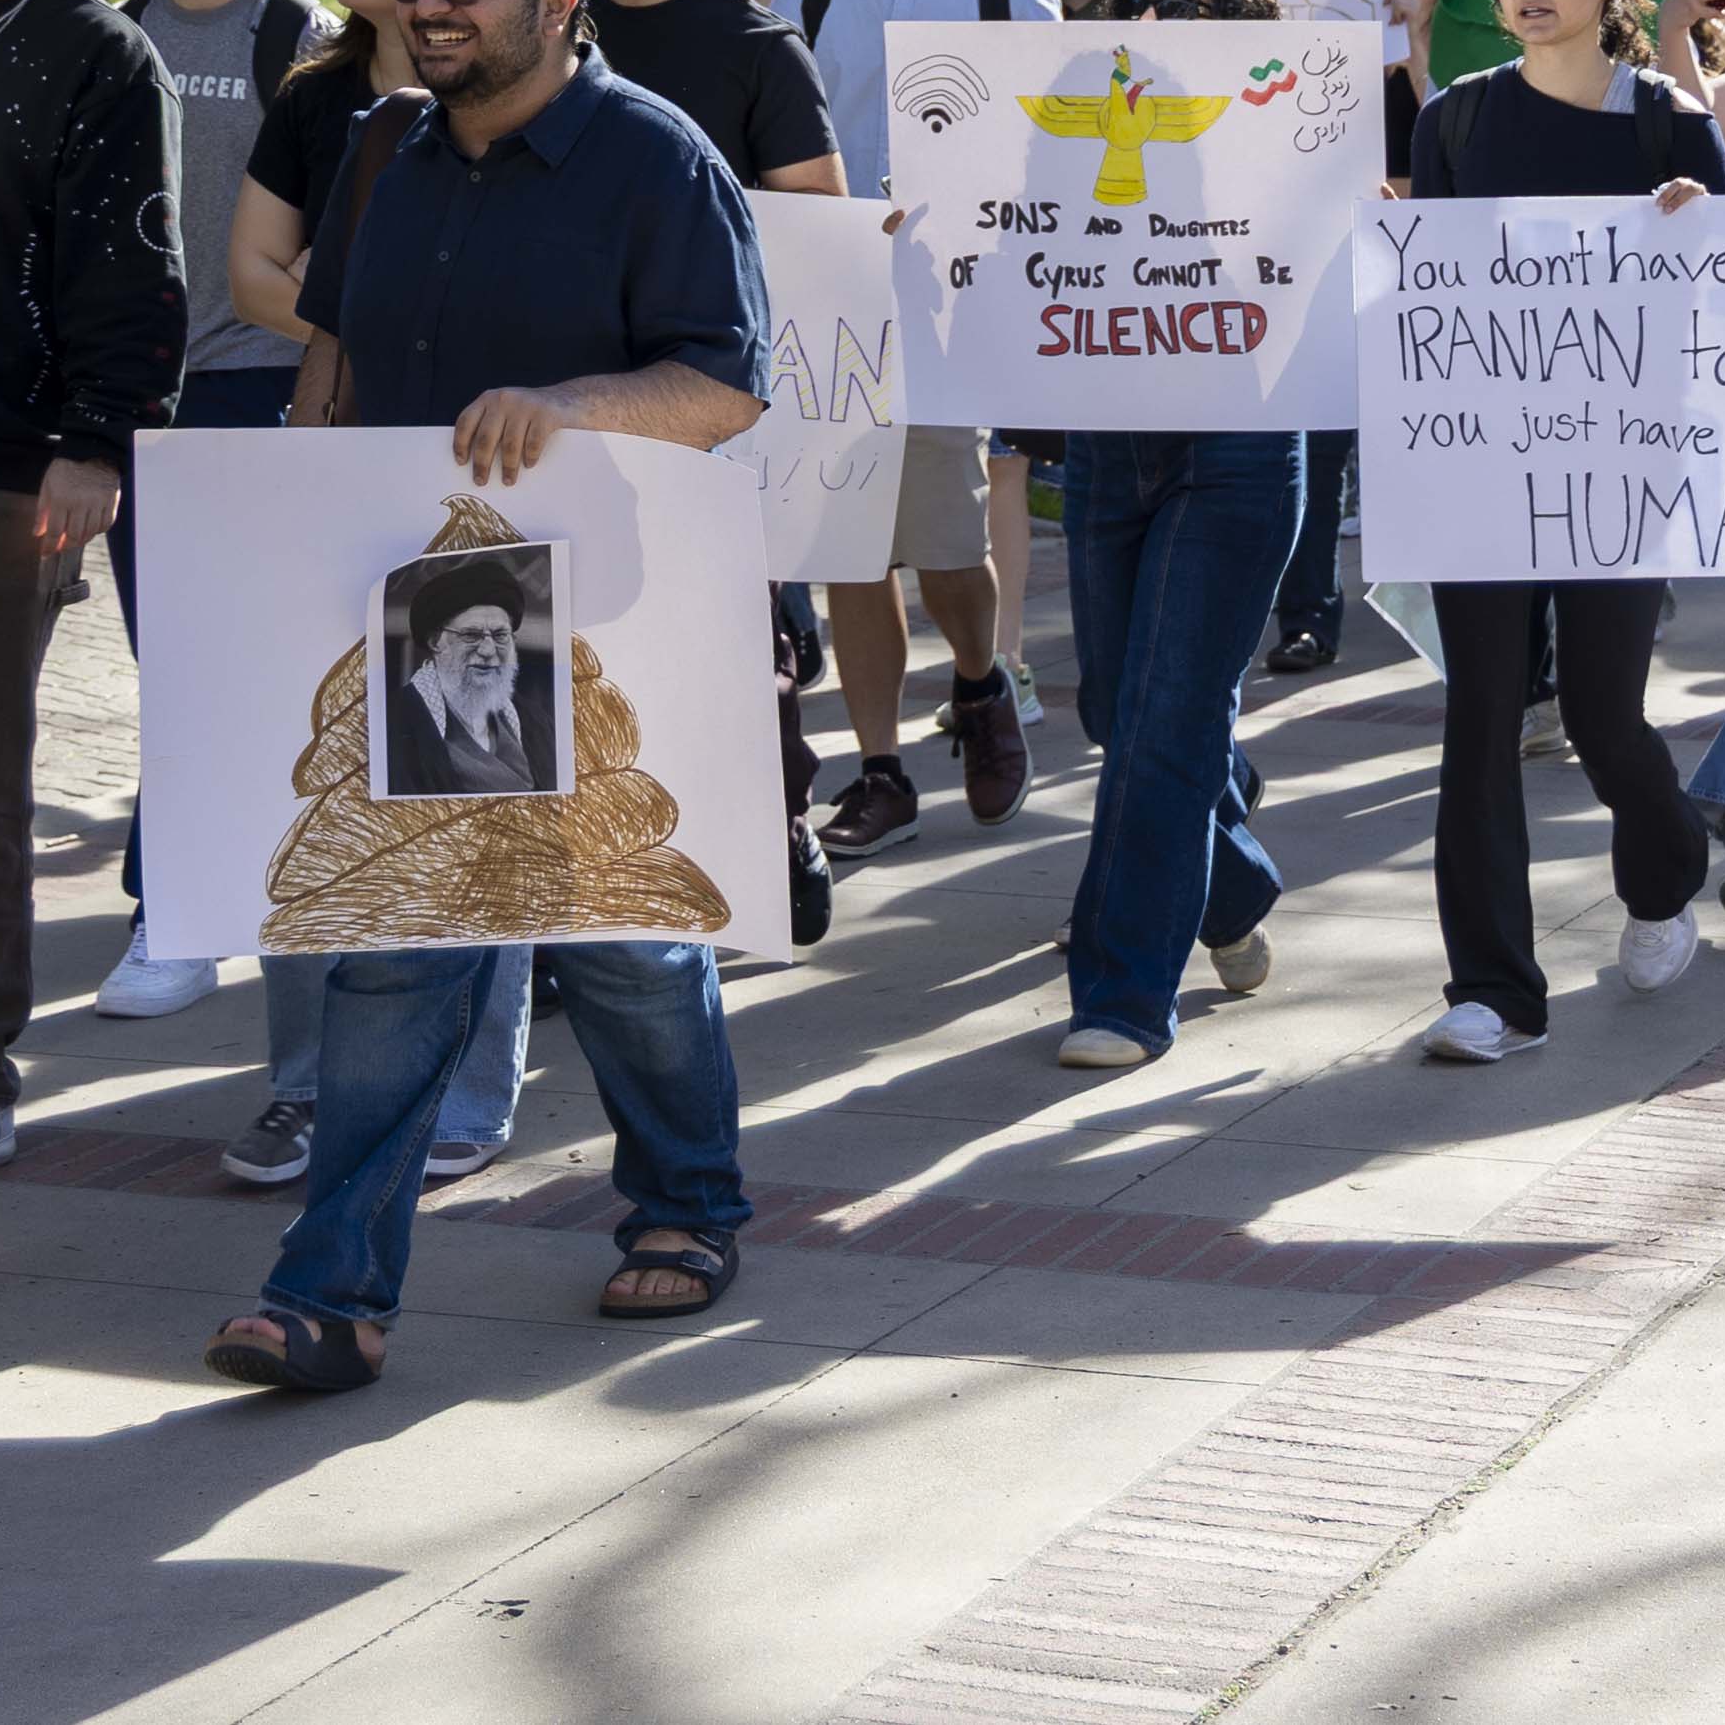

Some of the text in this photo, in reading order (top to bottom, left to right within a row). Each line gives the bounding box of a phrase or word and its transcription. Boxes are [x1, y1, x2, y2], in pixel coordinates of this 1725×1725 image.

[1302, 38, 1342, 76] زن
[174, 73, 247, 100] OCCER
[1294, 98, 1360, 152] آزادی
[975, 201, 1251, 237] SONS AND DAUGHTERS
[949, 251, 1294, 300] OF CYRUS CANNOT BE
[1377, 215, 1467, 292] You
[1489, 222, 1593, 287] don't
[1036, 301, 1268, 357] SILENCED
[1397, 305, 1648, 388] IRANIAN
[770, 316, 893, 428] AN
[1401, 408, 1485, 451] you
[1511, 401, 1599, 454] just
[1619, 409, 1719, 456] have
